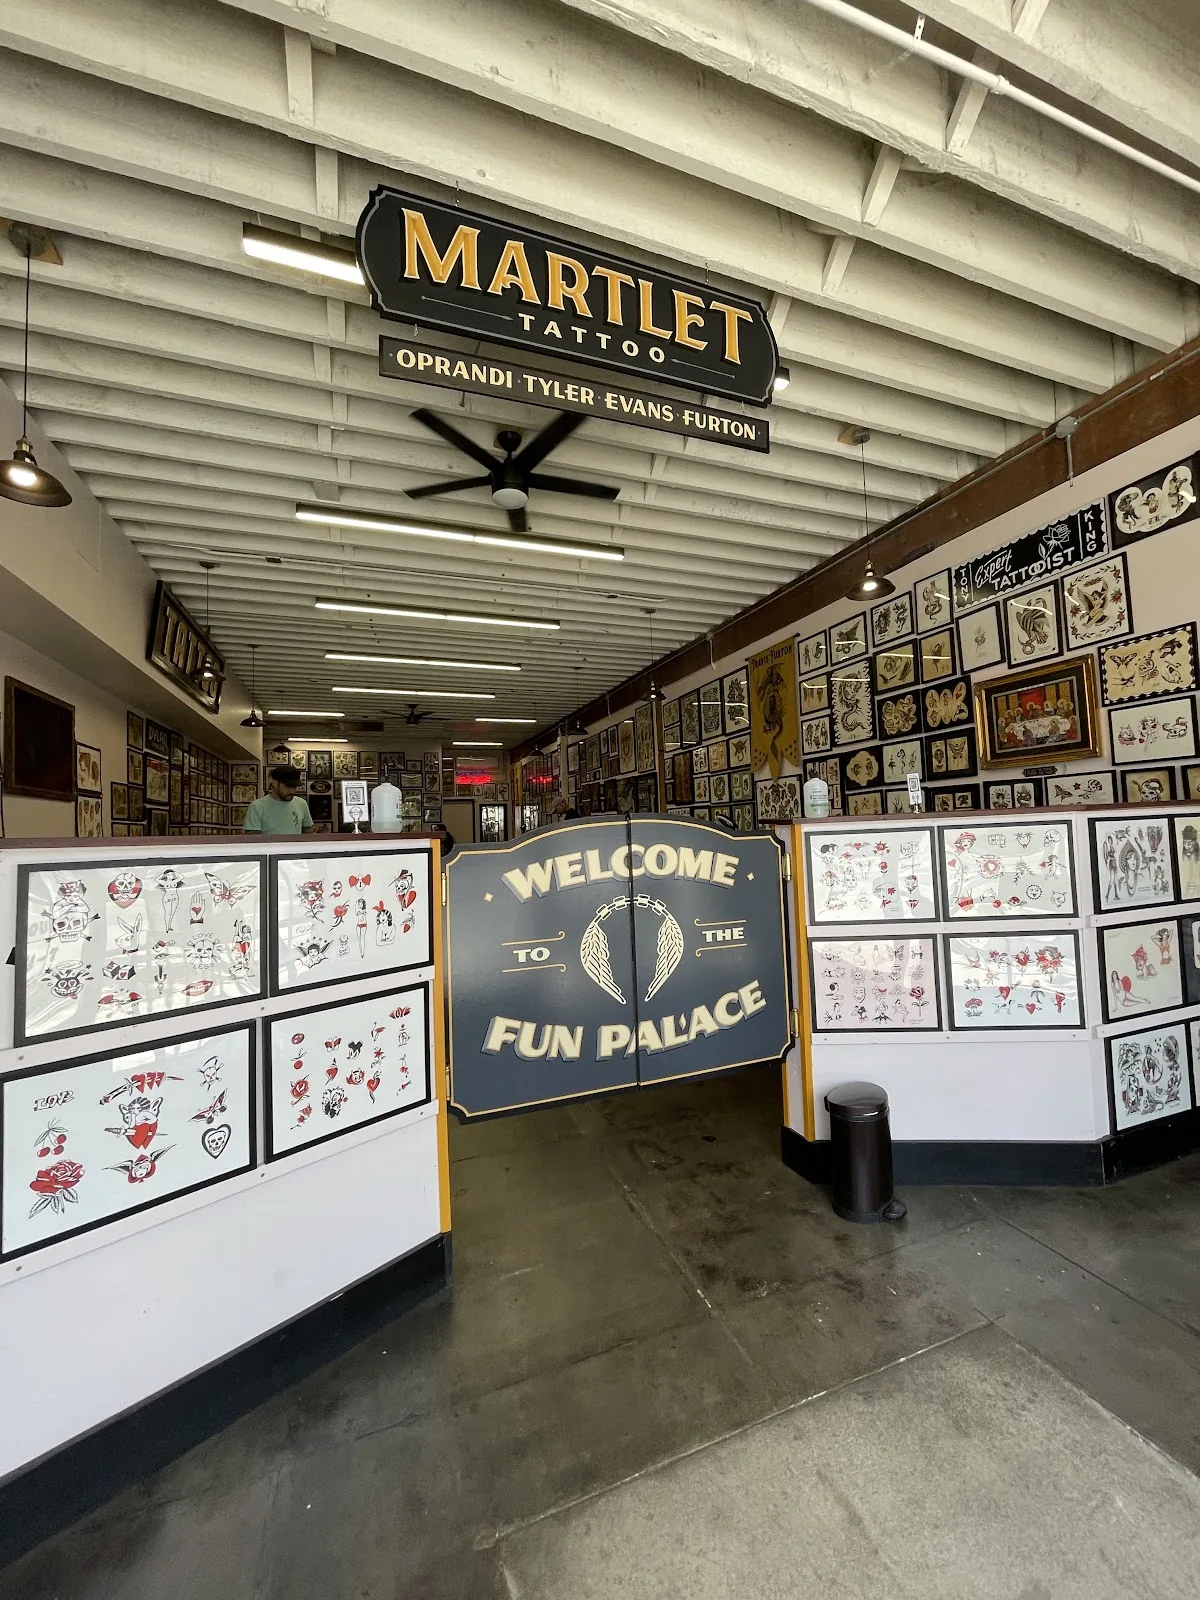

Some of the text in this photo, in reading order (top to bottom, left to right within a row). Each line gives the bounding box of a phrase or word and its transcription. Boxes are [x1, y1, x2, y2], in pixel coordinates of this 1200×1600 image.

[401, 206, 753, 366] MARTLET
[518, 312, 666, 364] TATTOO
[396, 348, 757, 441] OPRANDI TYLER EVANS FURTON
[1083, 509, 1097, 553] KING
[959, 567, 970, 602] TONY
[974, 549, 1013, 589] Expert
[991, 546, 1075, 591] TATTOOIST
[500, 843, 740, 903] WELCOME
[192, 932, 214, 941] LOVE
[512, 946, 551, 963] TO
[701, 926, 745, 943] THE
[192, 962, 216, 970] LESS
[481, 1015, 584, 1062] FUN
